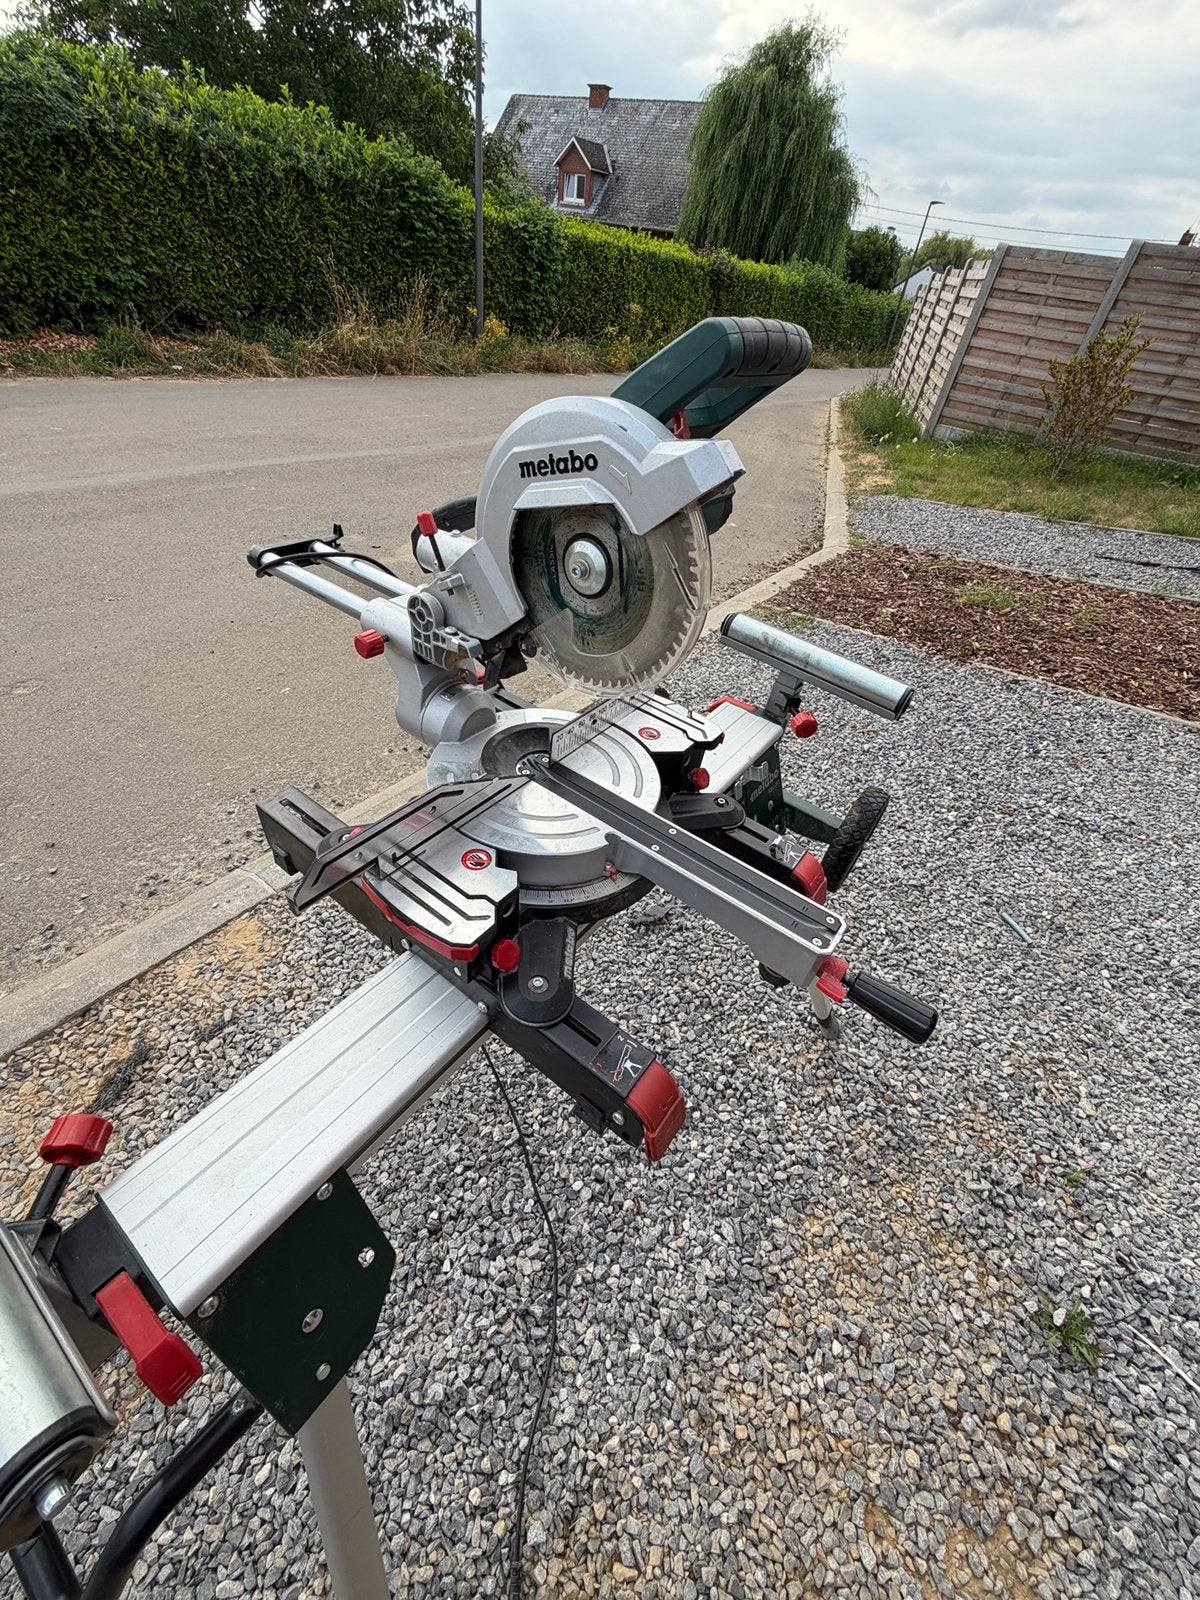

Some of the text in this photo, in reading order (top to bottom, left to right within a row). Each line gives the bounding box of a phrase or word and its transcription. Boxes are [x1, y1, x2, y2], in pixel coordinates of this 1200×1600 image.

[518, 449, 599, 478] metabo
[555, 733, 564, 743] 20
[567, 726, 575, 735] 40
[750, 769, 779, 802] metabo
[563, 926, 576, 980] metabo
